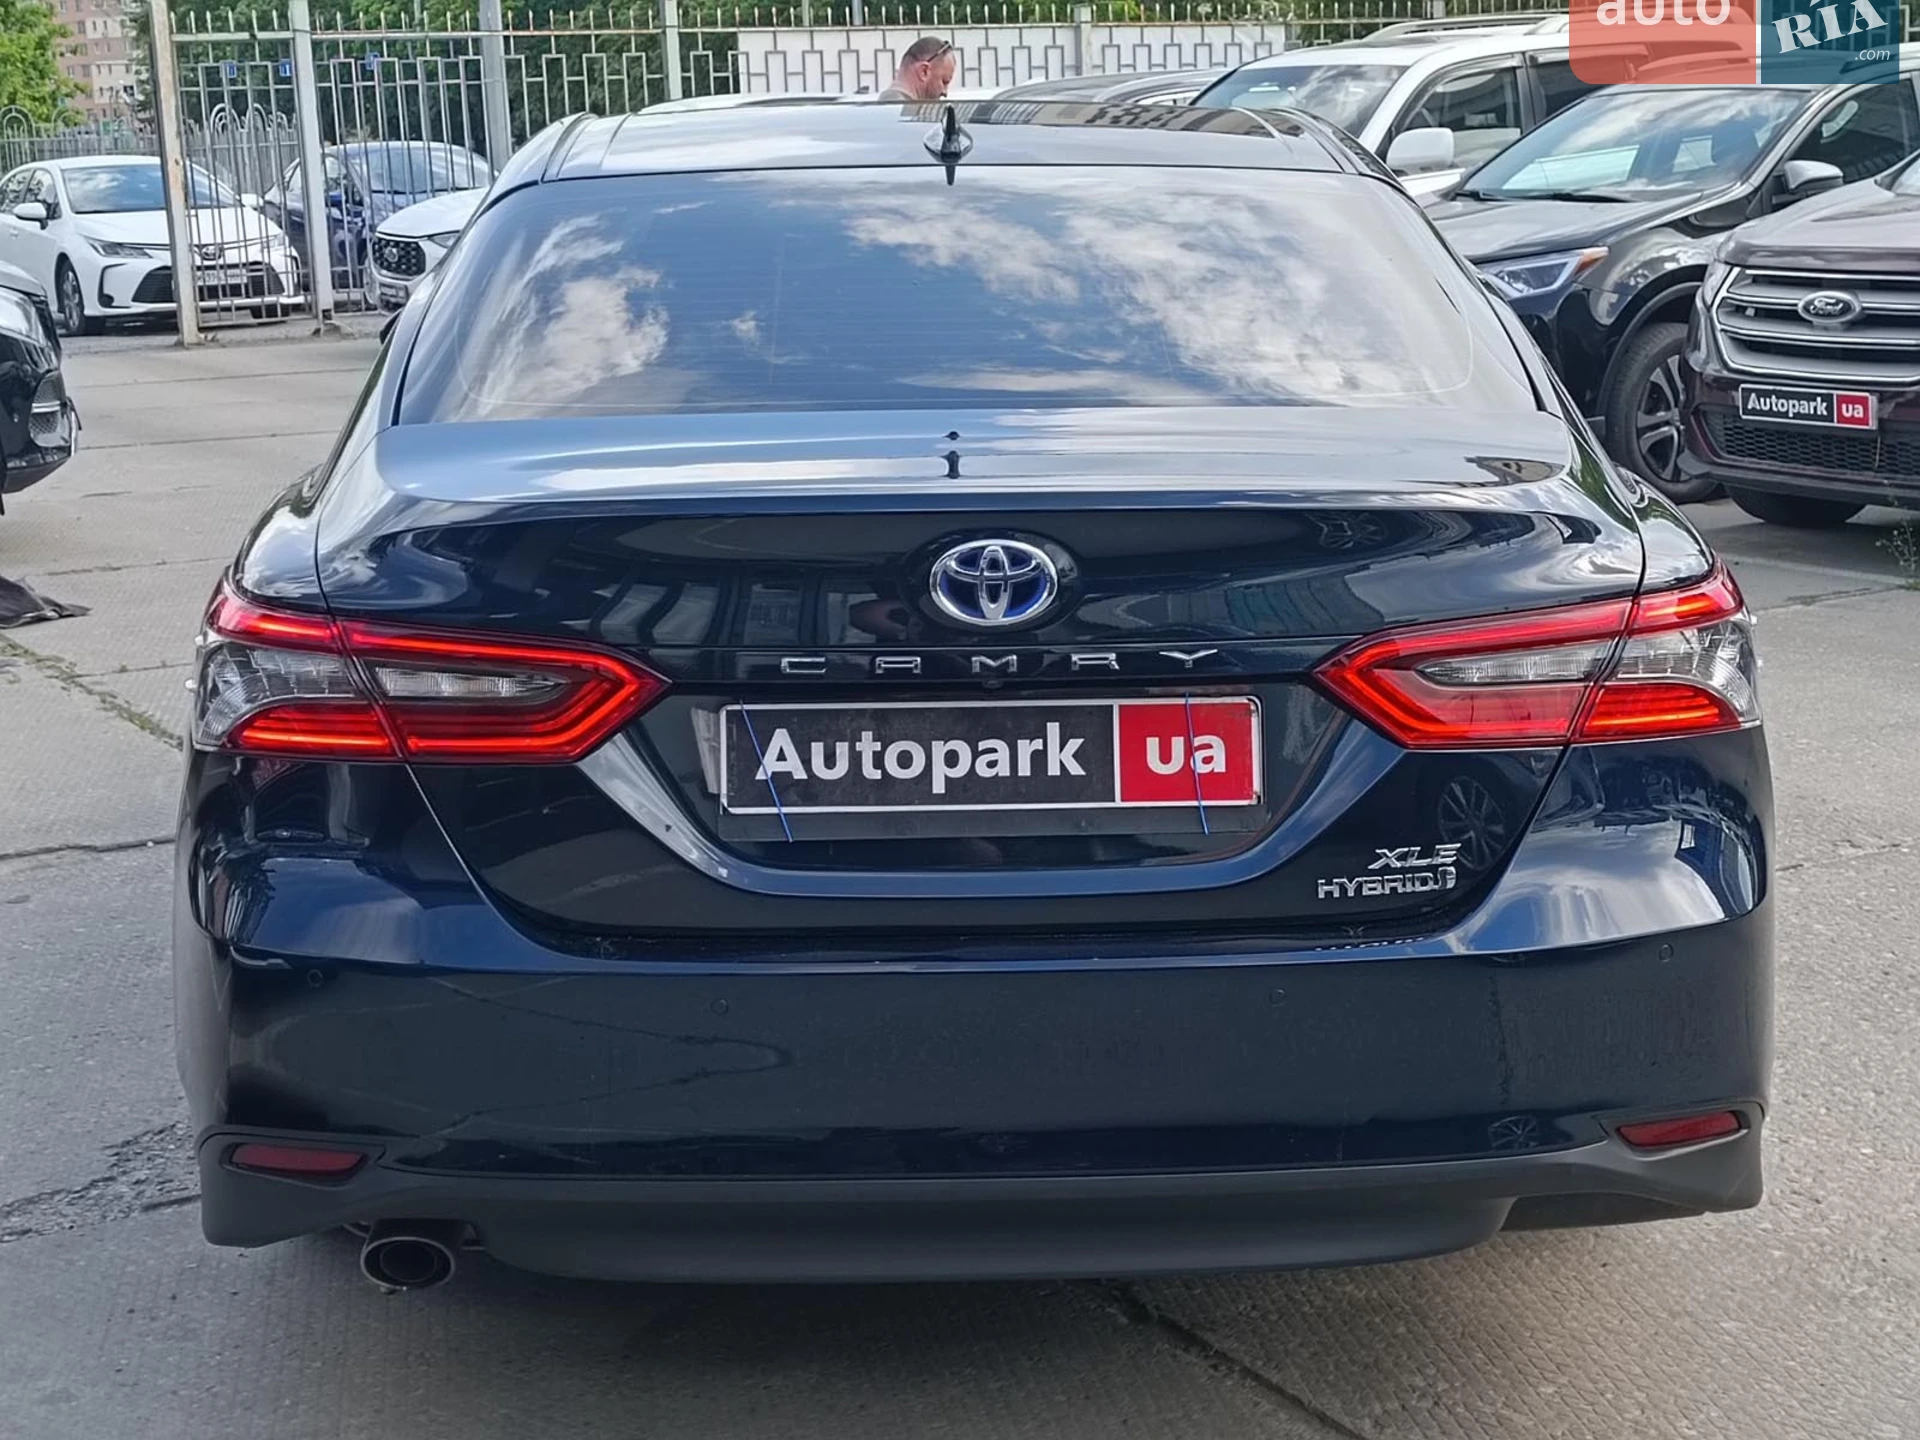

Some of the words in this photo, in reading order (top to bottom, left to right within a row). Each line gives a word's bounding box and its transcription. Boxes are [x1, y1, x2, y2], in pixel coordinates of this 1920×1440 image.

[1809, 297, 1844, 315] Ford
[1747, 392, 1828, 418] Autopark
[1841, 403, 1864, 418] ua
[781, 649, 1218, 674] CAMRY
[755, 721, 1086, 794] Autopark
[1145, 732, 1227, 776] ua
[1367, 843, 1461, 869] XLE
[1317, 873, 1433, 899] HYBRID
